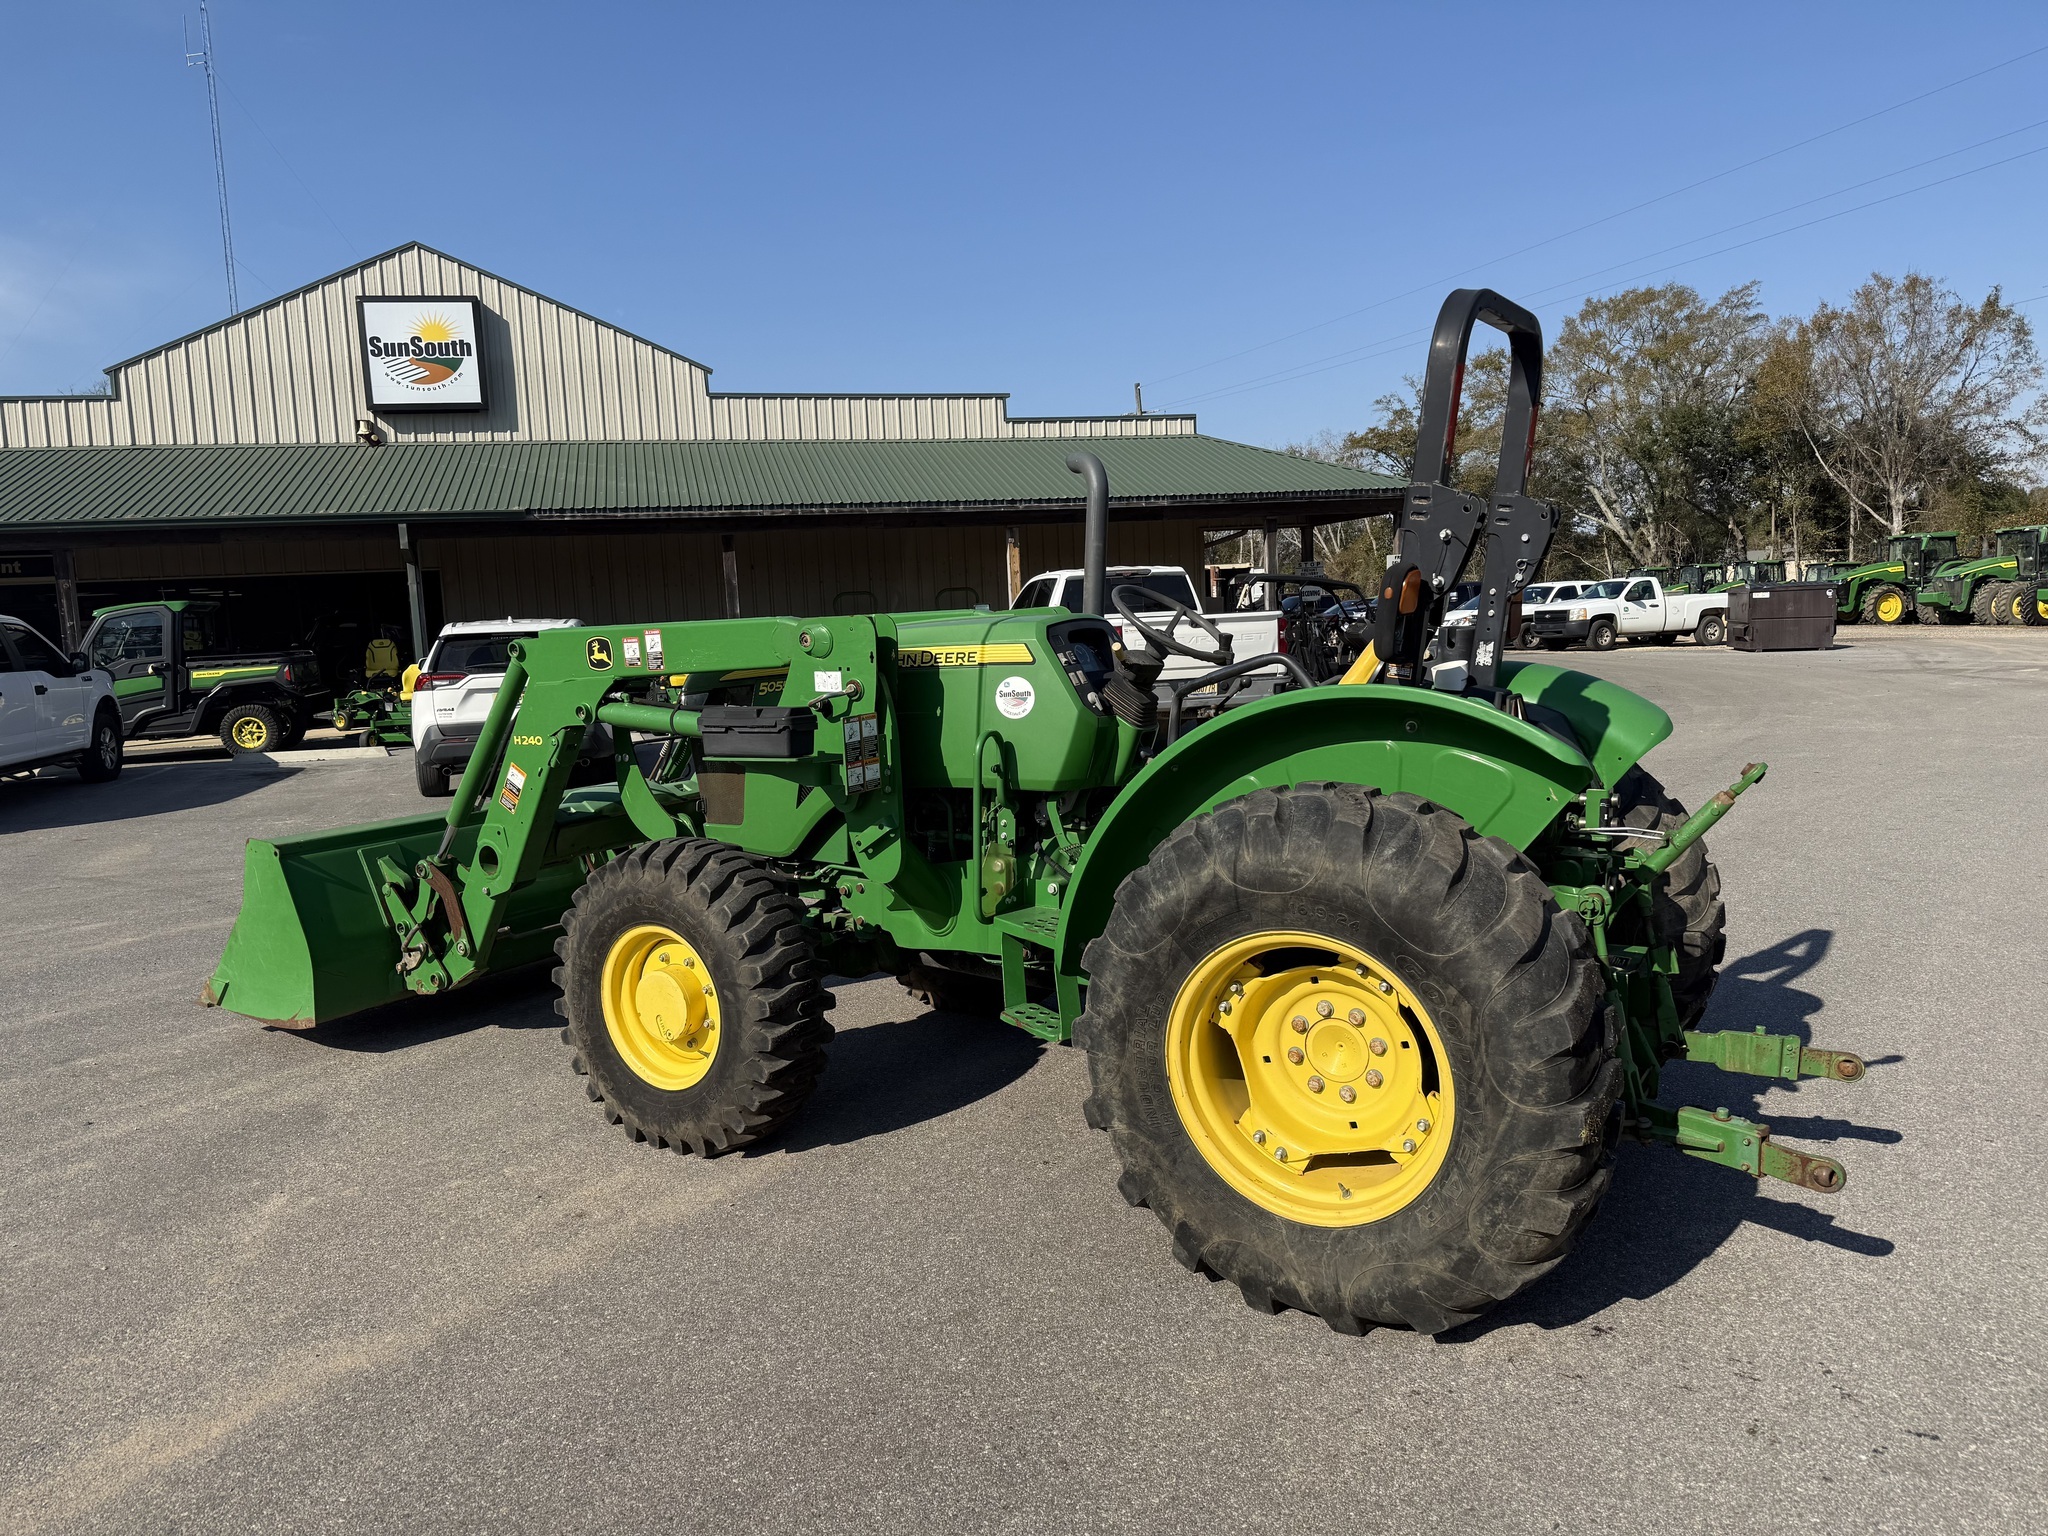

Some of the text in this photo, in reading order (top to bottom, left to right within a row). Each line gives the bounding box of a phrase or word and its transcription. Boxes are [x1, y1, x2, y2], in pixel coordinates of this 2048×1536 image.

[368, 336, 472, 357] SunSouth
[384, 371, 464, 391] www.sunsouth.com
[920, 650, 978, 665] DEERE
[998, 689, 1032, 698] SunSouth
[513, 735, 543, 746] H240
